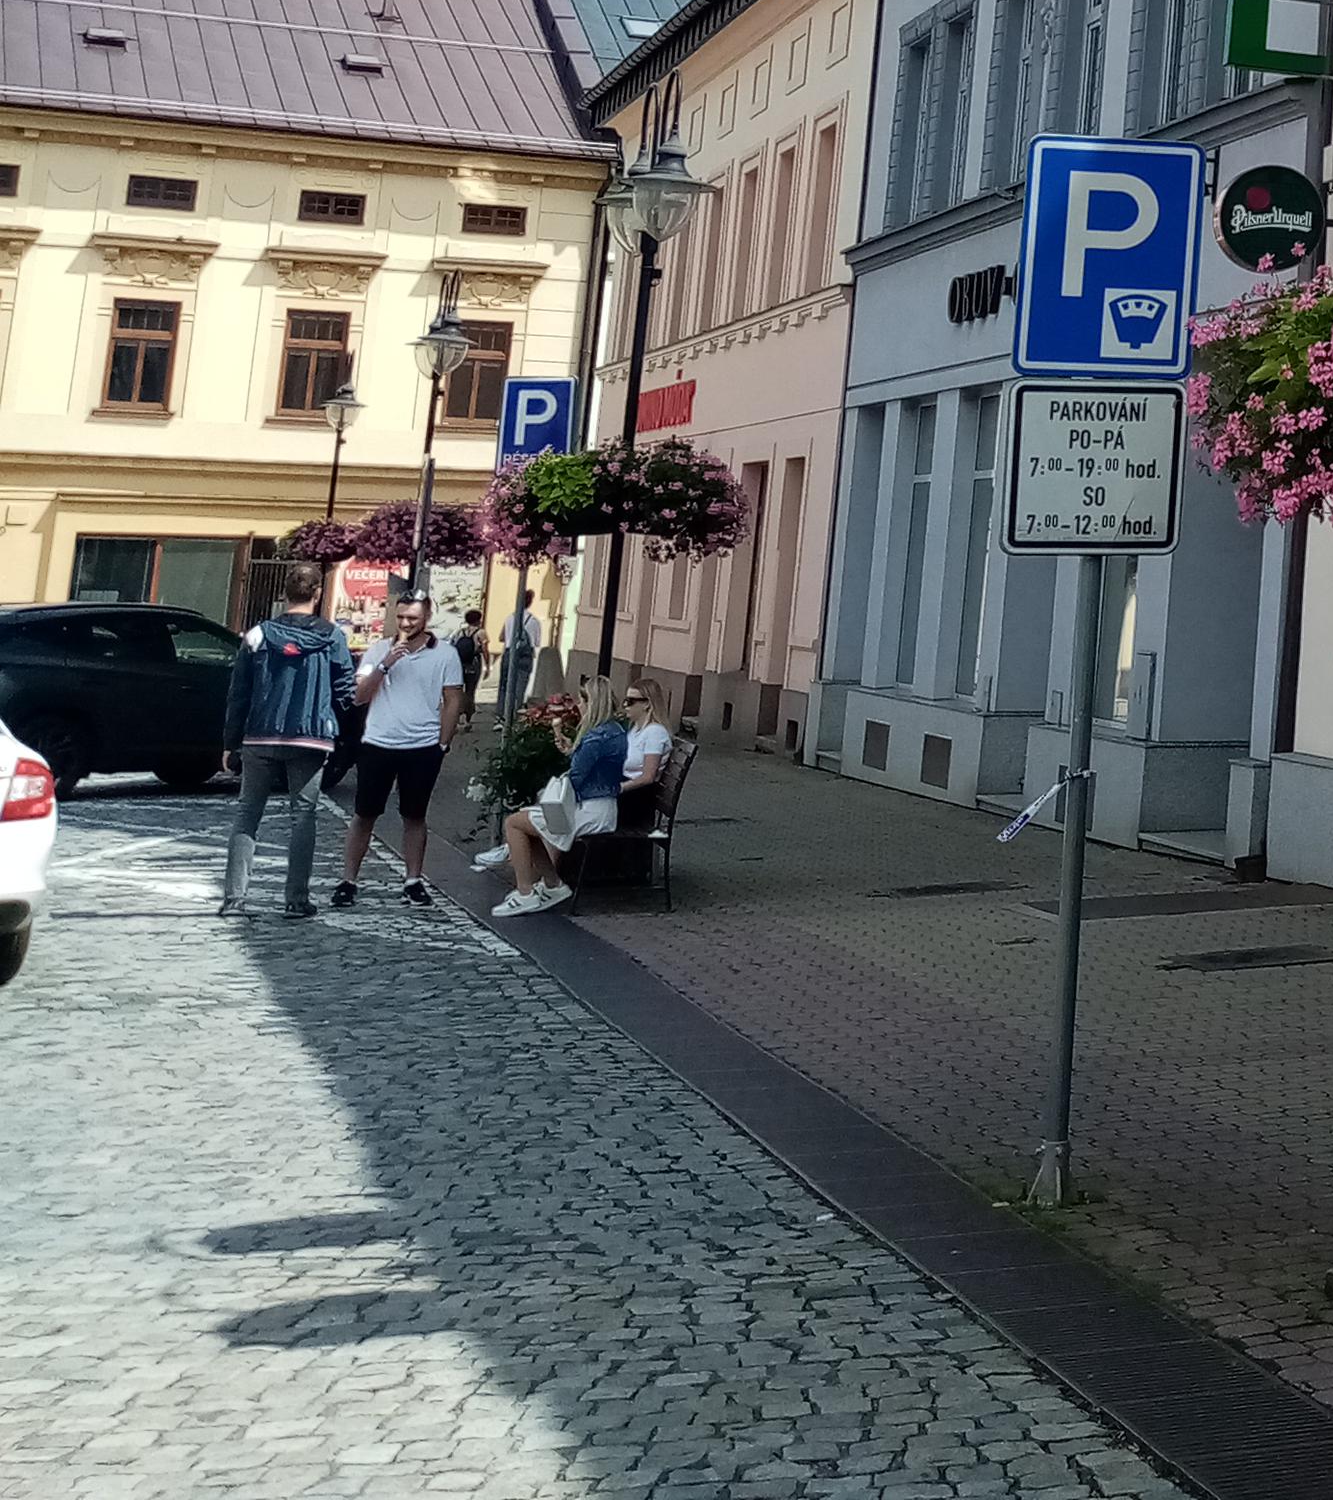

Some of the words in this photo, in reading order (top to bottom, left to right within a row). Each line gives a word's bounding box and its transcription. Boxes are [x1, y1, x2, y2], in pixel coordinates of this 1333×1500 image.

[1230, 203, 1274, 235] Pilsner
[1273, 205, 1313, 233] Urquell
[1061, 170, 1160, 298] P
[513, 388, 558, 447] P
[1049, 396, 1149, 422] PARKOVÁNÍ
[1068, 425, 1125, 450] PO-PÁ
[1125, 458, 1161, 479] hod.
[1082, 486, 1106, 507] SO
[1121, 515, 1157, 536] hod.
